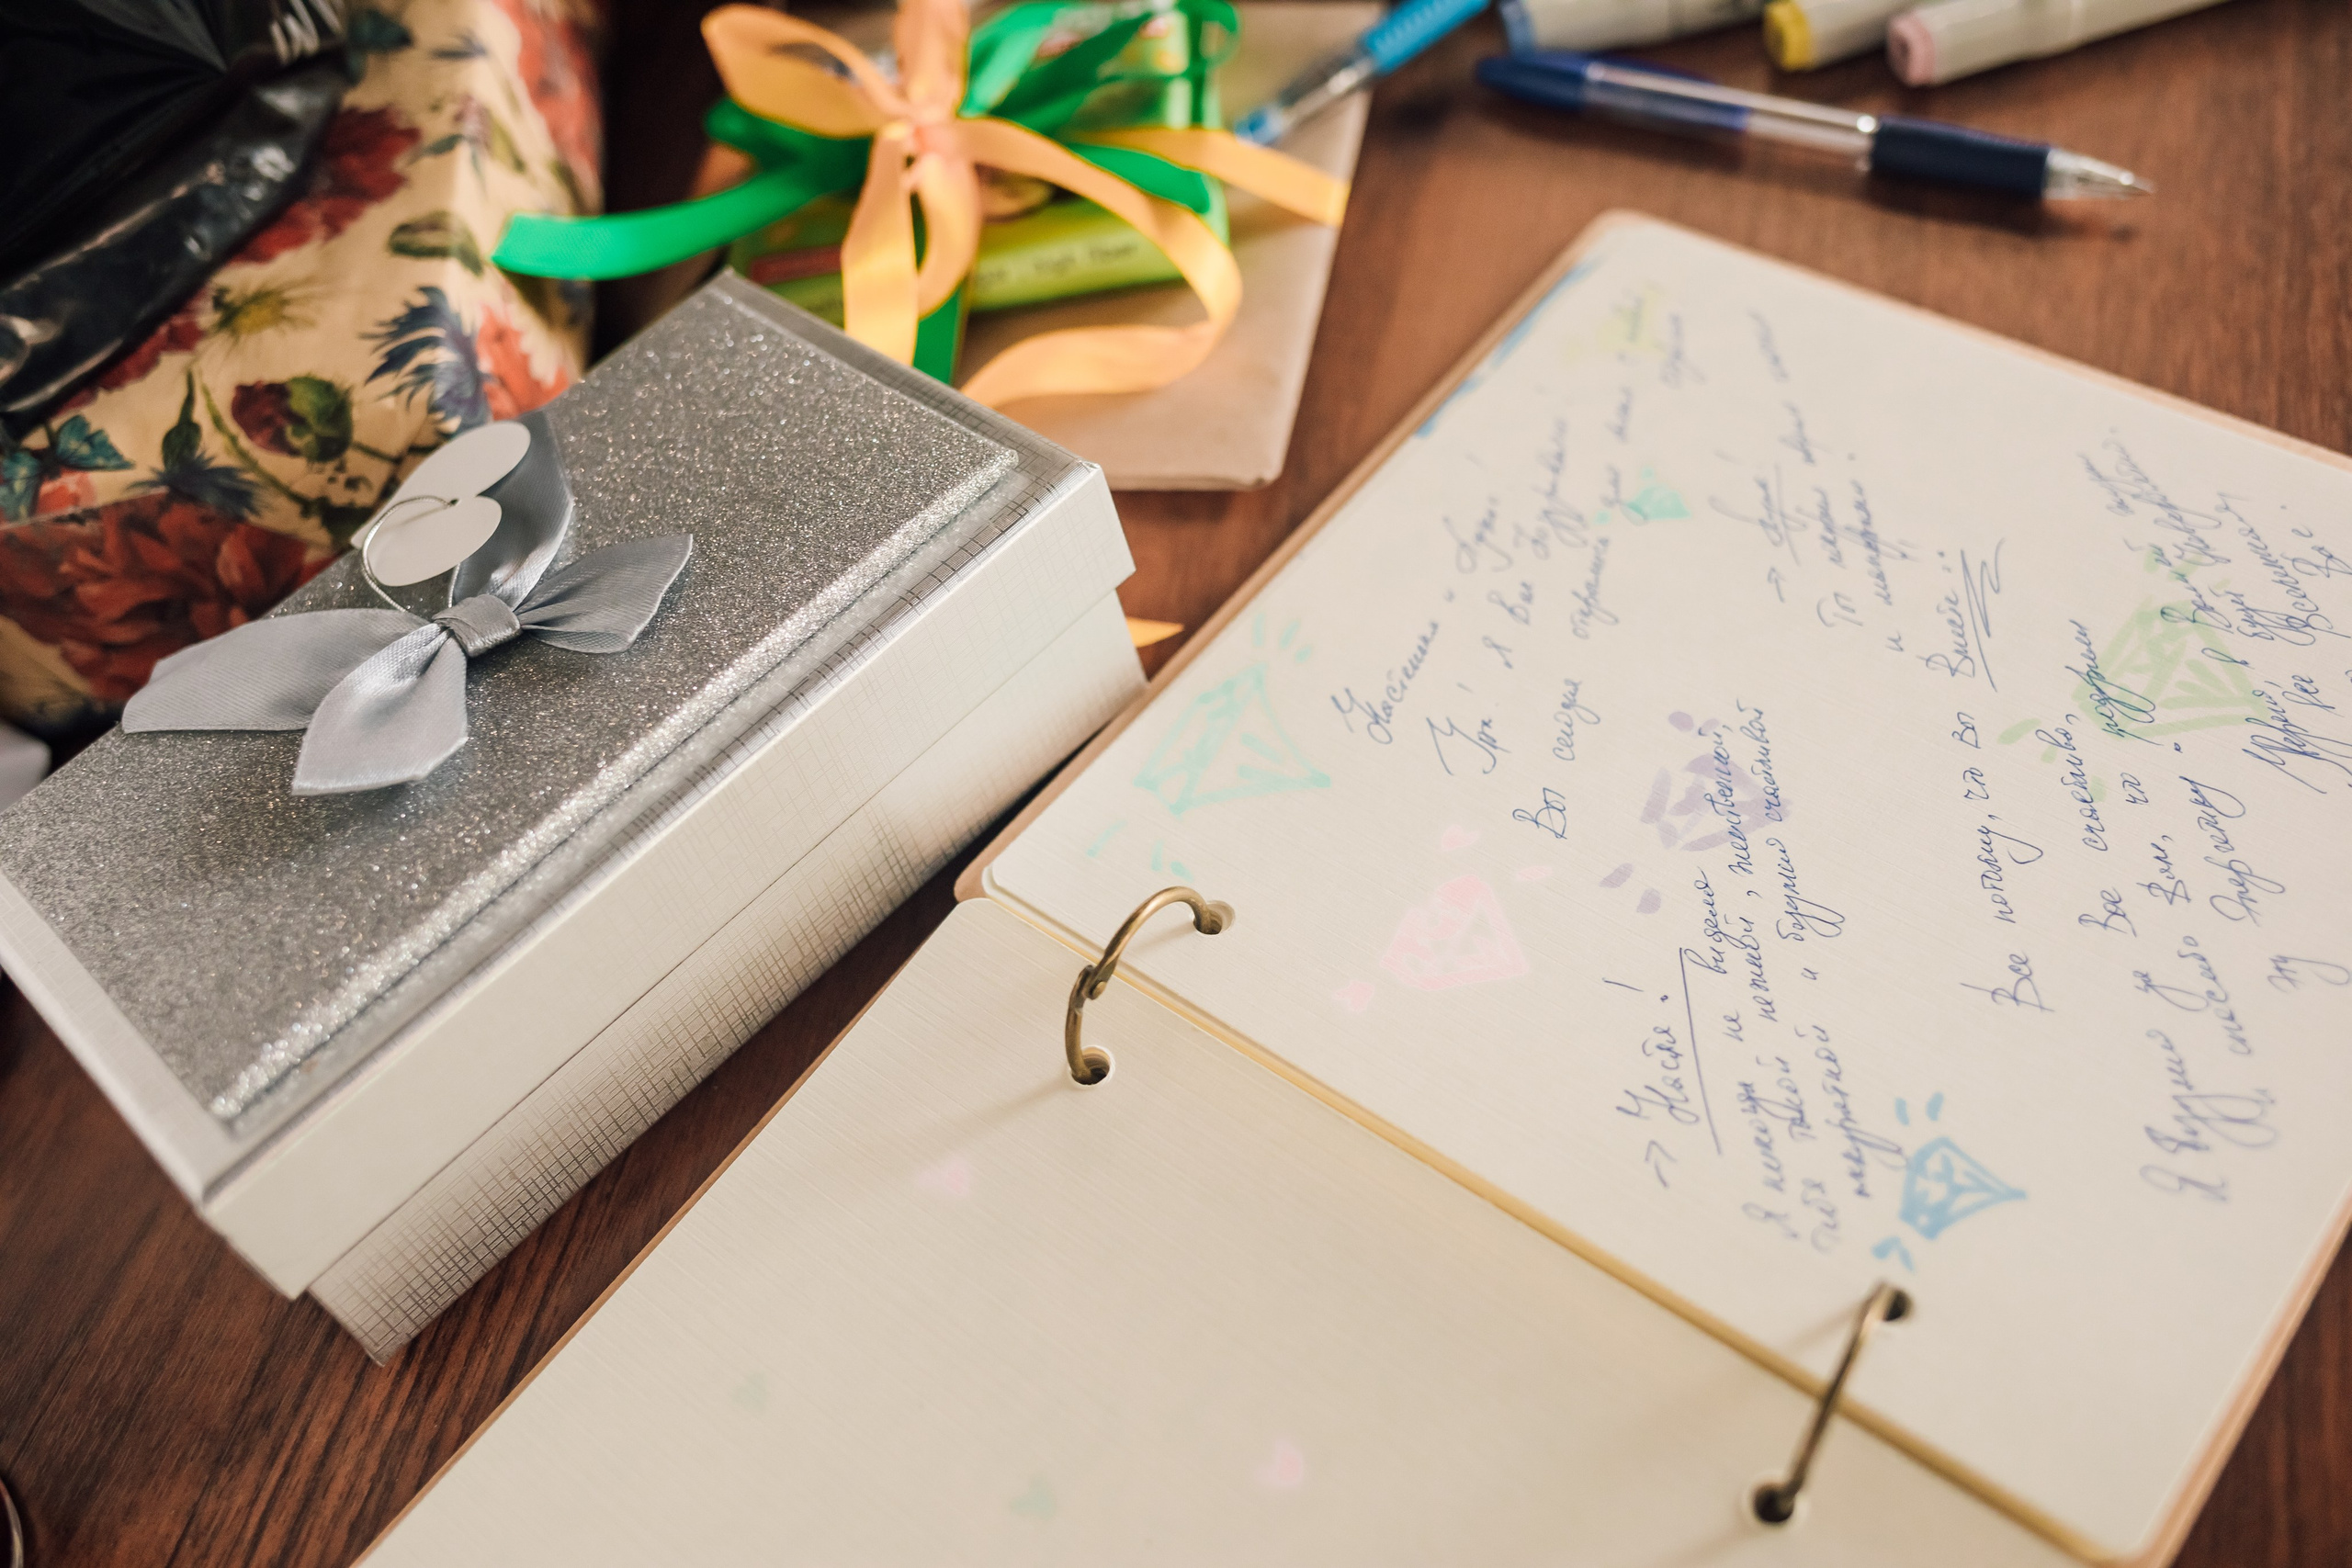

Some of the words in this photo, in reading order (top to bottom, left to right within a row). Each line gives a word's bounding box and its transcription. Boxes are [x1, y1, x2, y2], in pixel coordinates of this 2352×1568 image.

[1512, 786, 1567, 840] Вы
[1553, 678, 1601, 761] сегодня
[1963, 769, 1990, 801] что
[2120, 772, 2149, 806] что
[1801, 967, 1819, 981] и
[1959, 953, 2055, 1012] Все
[1722, 1010, 1745, 1043] не
